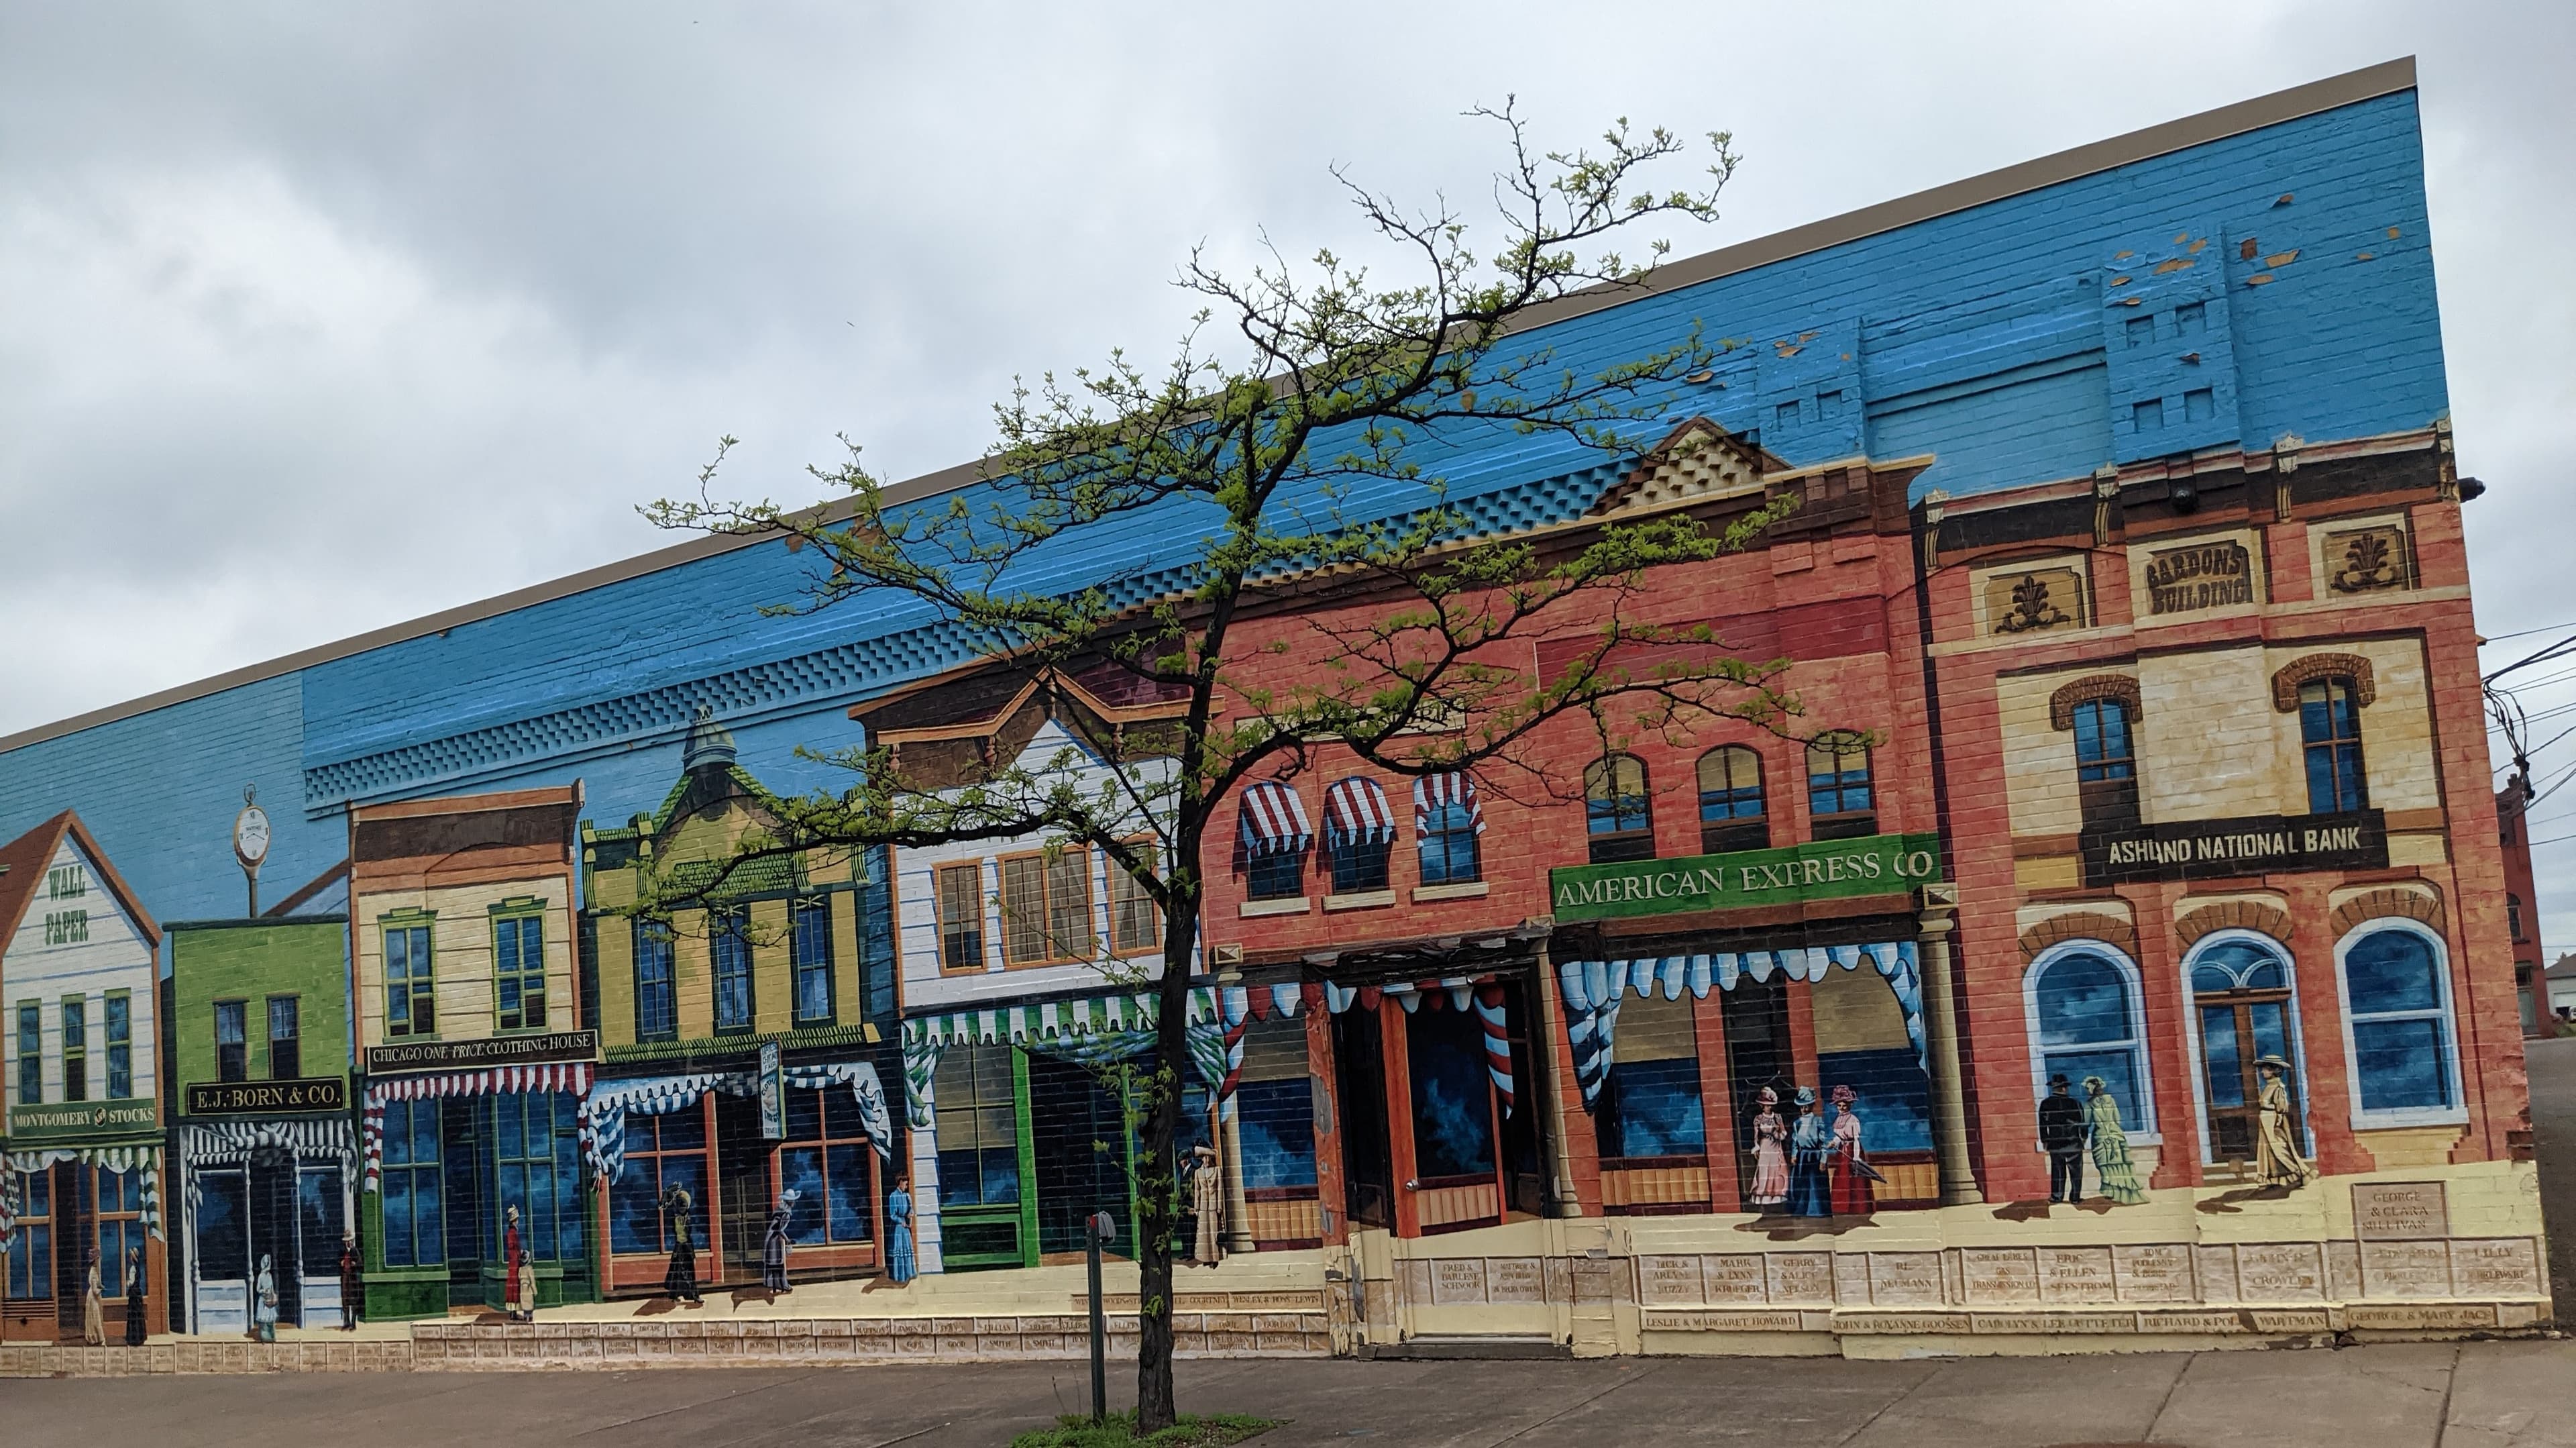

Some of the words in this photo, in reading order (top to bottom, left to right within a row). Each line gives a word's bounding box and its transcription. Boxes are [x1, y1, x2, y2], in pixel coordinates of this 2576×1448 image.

[2151, 578, 2246, 615] BUILDING
[2197, 831, 2298, 860] NATIONAL
[2304, 826, 2361, 853] BANK
[48, 865, 86, 902] WALL
[1556, 868, 1723, 908] AMERICAN
[1740, 852, 1880, 892] EXPRESS
[1893, 850, 1933, 878] CO
[45, 909, 89, 945] PAPER
[373, 1046, 422, 1063] CHICAGO
[424, 1046, 448, 1060] ONE
[452, 1043, 485, 1058] PRICE
[486, 1037, 548, 1055] CLOTHING
[549, 1034, 591, 1049] HOUSE
[232, 1087, 284, 1107] BORN
[289, 1086, 303, 1104] &
[308, 1085, 341, 1104] CO.
[14, 1110, 91, 1127] MONTGOMERY
[109, 1107, 154, 1123] STOCKS
[2373, 1192, 2421, 1202] GEORGE
[2371, 1206, 2381, 1217] &
[2383, 1206, 2428, 1217] CLARA
[2362, 1219, 2426, 1231] SULLIVAN
[1443, 1263, 1465, 1272] FRED
[1720, 1259, 1752, 1268] MARK
[1782, 1258, 1816, 1268] GERRY
[1646, 1317, 1680, 1327] LESLIE
[1683, 1317, 1690, 1327] &
[1693, 1317, 1750, 1327] MARGARET
[1752, 1316, 1796, 1326] HOWARD
[2143, 1316, 2200, 1327] RICHARD
[2202, 1317, 2212, 1327] &
[2259, 1315, 2325, 1327] WARTMAN
[2351, 1310, 2402, 1321] GEORGE
[2407, 1310, 2415, 1320] &
[2418, 1310, 2455, 1321] MARY
[1833, 1321, 1860, 1329] JOHN
[1863, 1321, 1871, 1329] &
